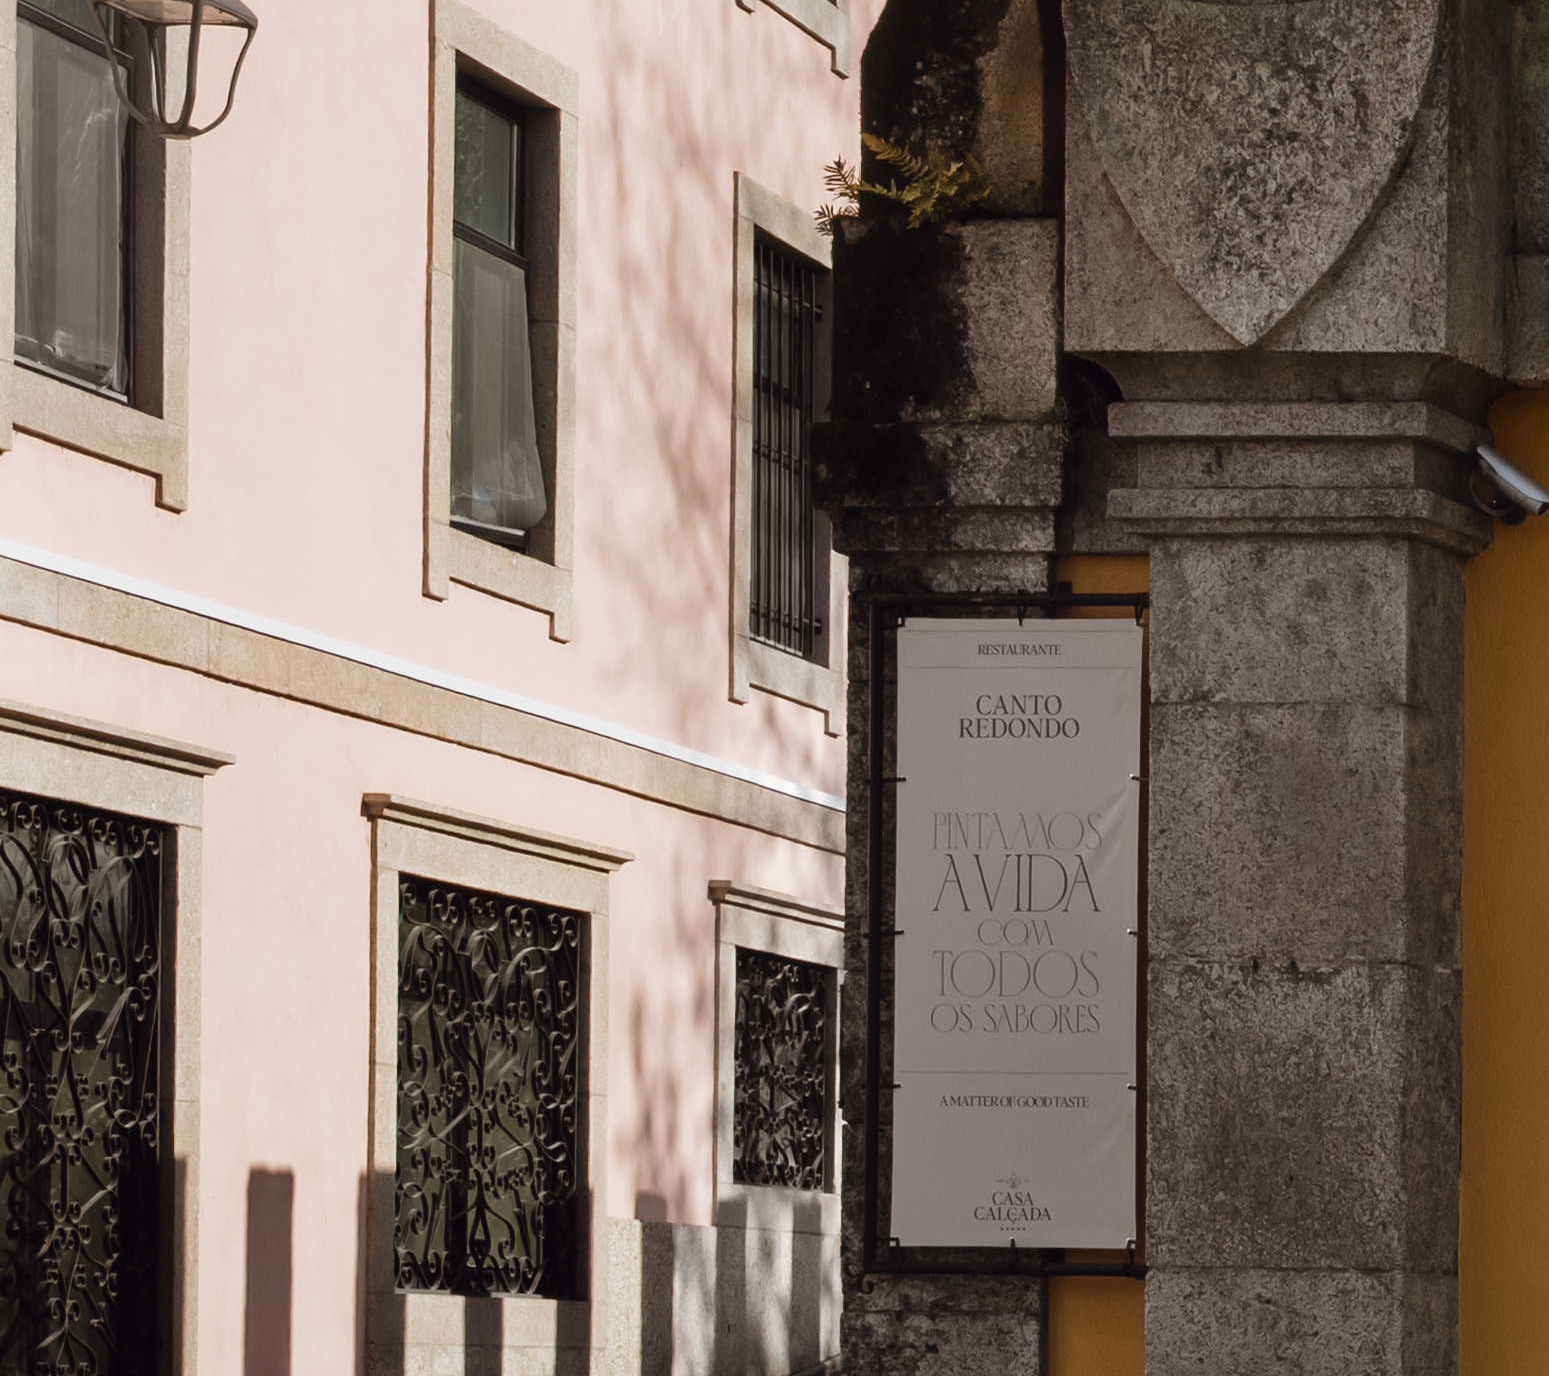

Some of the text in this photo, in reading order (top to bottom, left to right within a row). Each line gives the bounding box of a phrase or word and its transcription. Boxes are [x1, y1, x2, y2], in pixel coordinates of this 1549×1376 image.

[977, 644, 1062, 656] RESTAURANTE
[975, 694, 1062, 716] CANTO
[958, 717, 1080, 739] REDONDO
[931, 811, 1103, 851] PINTAMOS
[931, 854, 1102, 913] A VIDA
[977, 918, 1054, 946] COM
[931, 949, 1100, 999] TODOS
[930, 1003, 1101, 1035] OS SABORES
[940, 1095, 1090, 1109] A MATTER OF GOOD TASTE
[991, 1190, 1034, 1206] CASA
[973, 1206, 1053, 1225] CALÇADA
